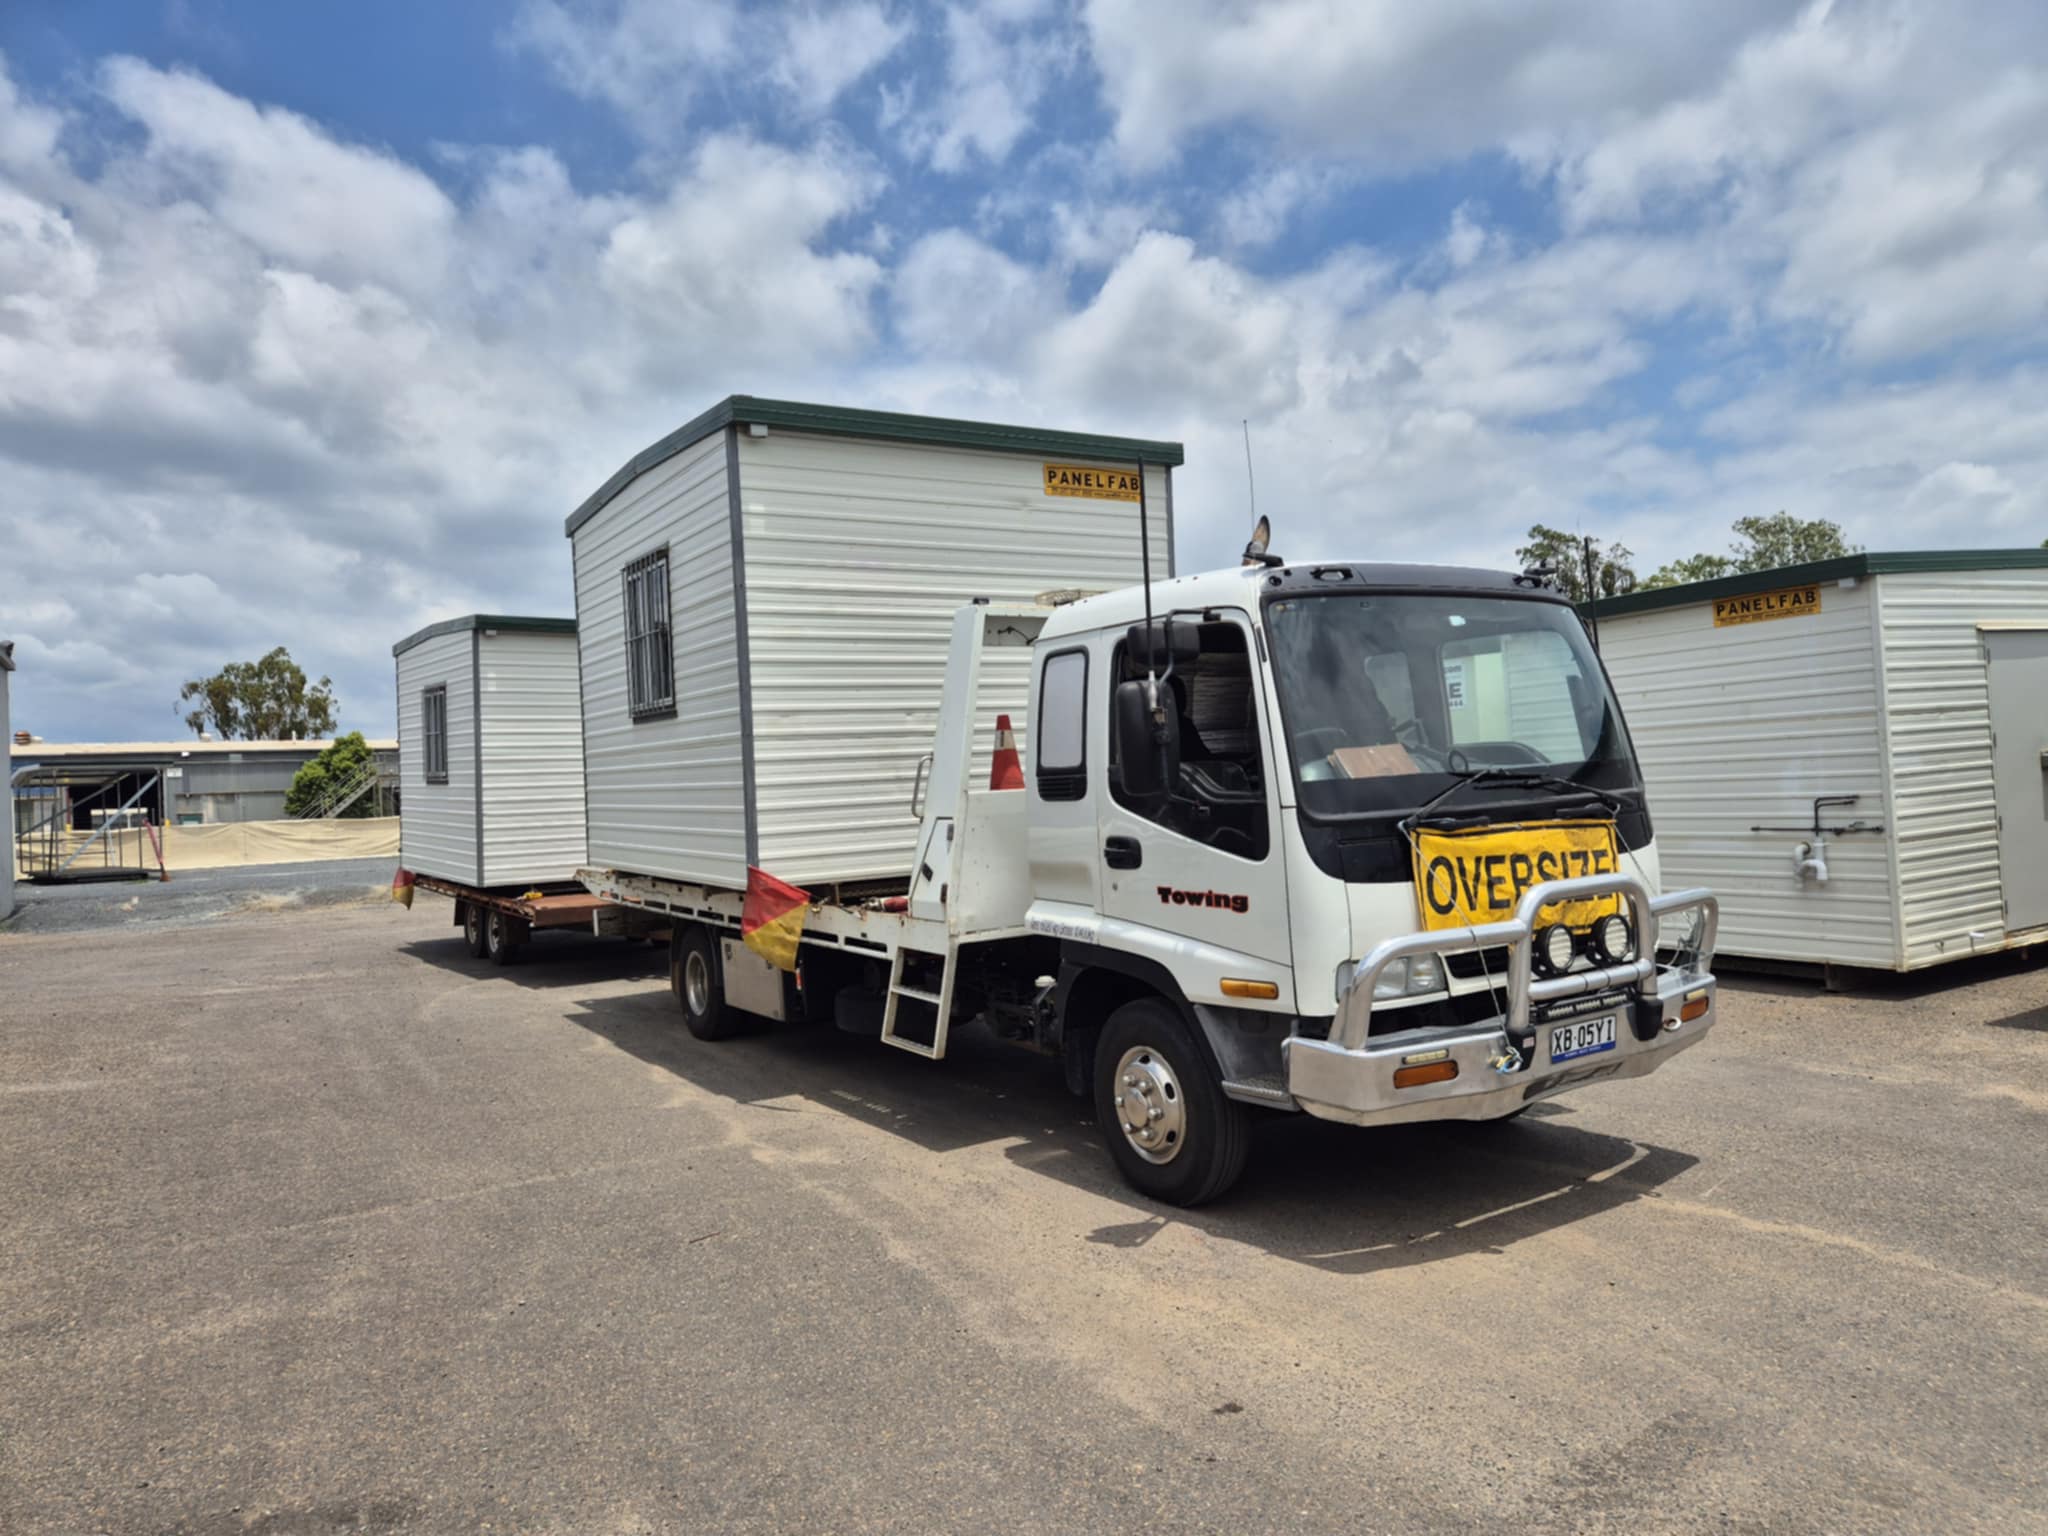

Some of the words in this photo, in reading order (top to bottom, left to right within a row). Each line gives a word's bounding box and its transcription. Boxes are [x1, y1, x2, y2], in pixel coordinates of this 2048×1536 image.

[1047, 469, 1139, 491] PANELFAB
[1716, 590, 1816, 617] PANELFAB
[1156, 885, 1249, 913] Towing
